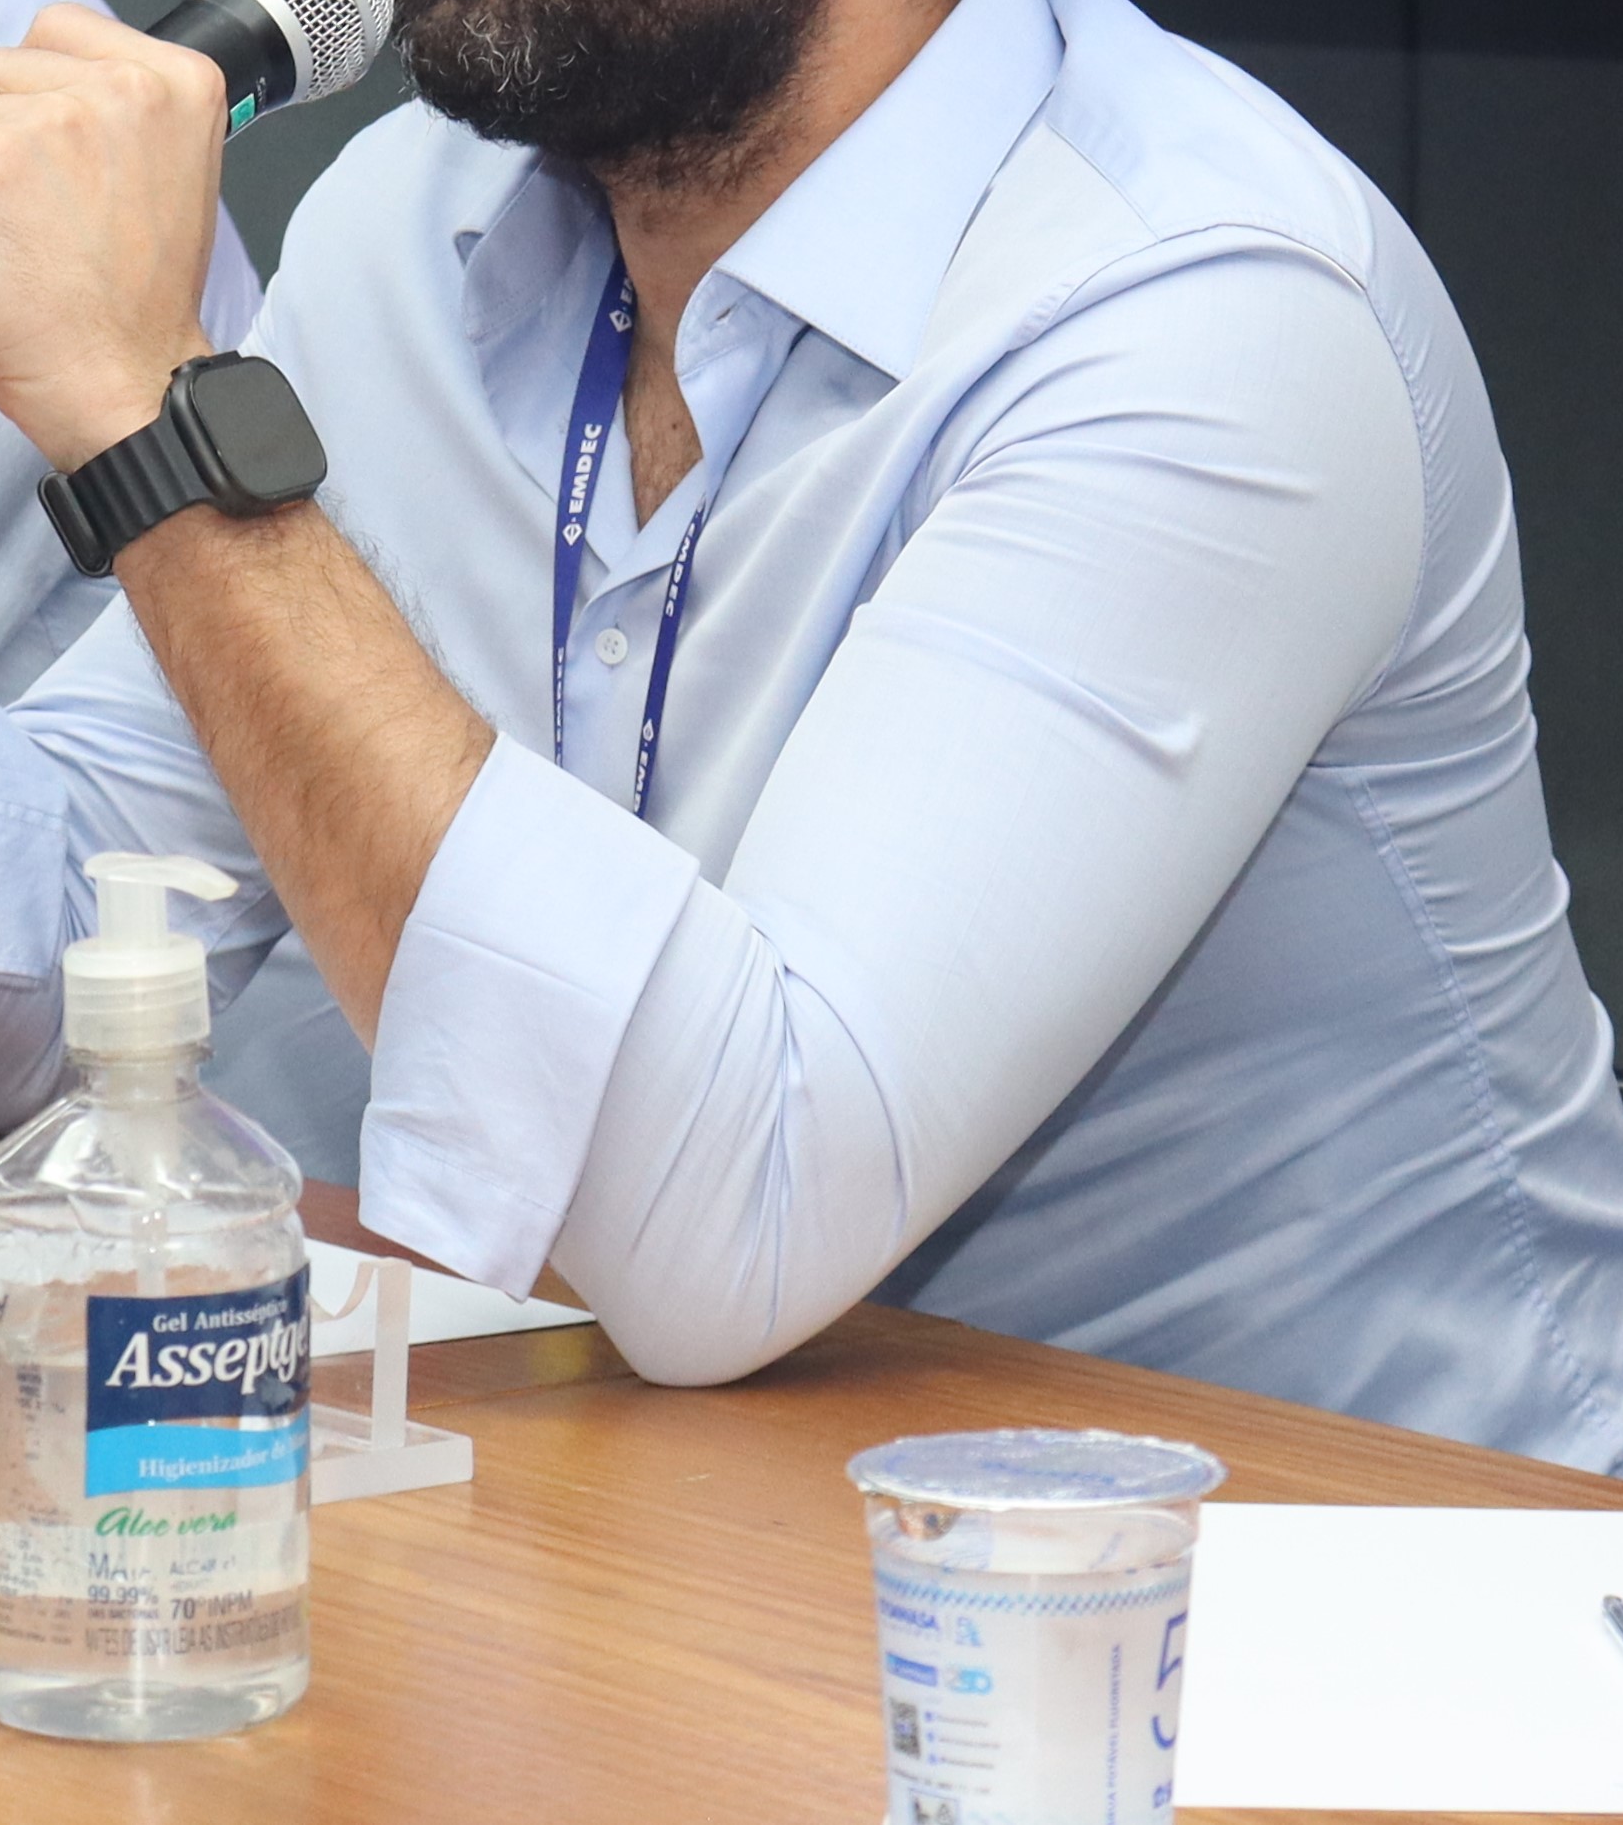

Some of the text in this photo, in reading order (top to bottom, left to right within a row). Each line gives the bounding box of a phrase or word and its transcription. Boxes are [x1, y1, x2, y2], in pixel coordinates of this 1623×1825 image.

[568, 422, 603, 514] EMDEC
[664, 521, 696, 618] EMDEC
[152, 1311, 188, 1333] Gel
[138, 1448, 271, 1483] Higienizador
[94, 1506, 171, 1537] Aloe
[176, 1510, 239, 1536] vera
